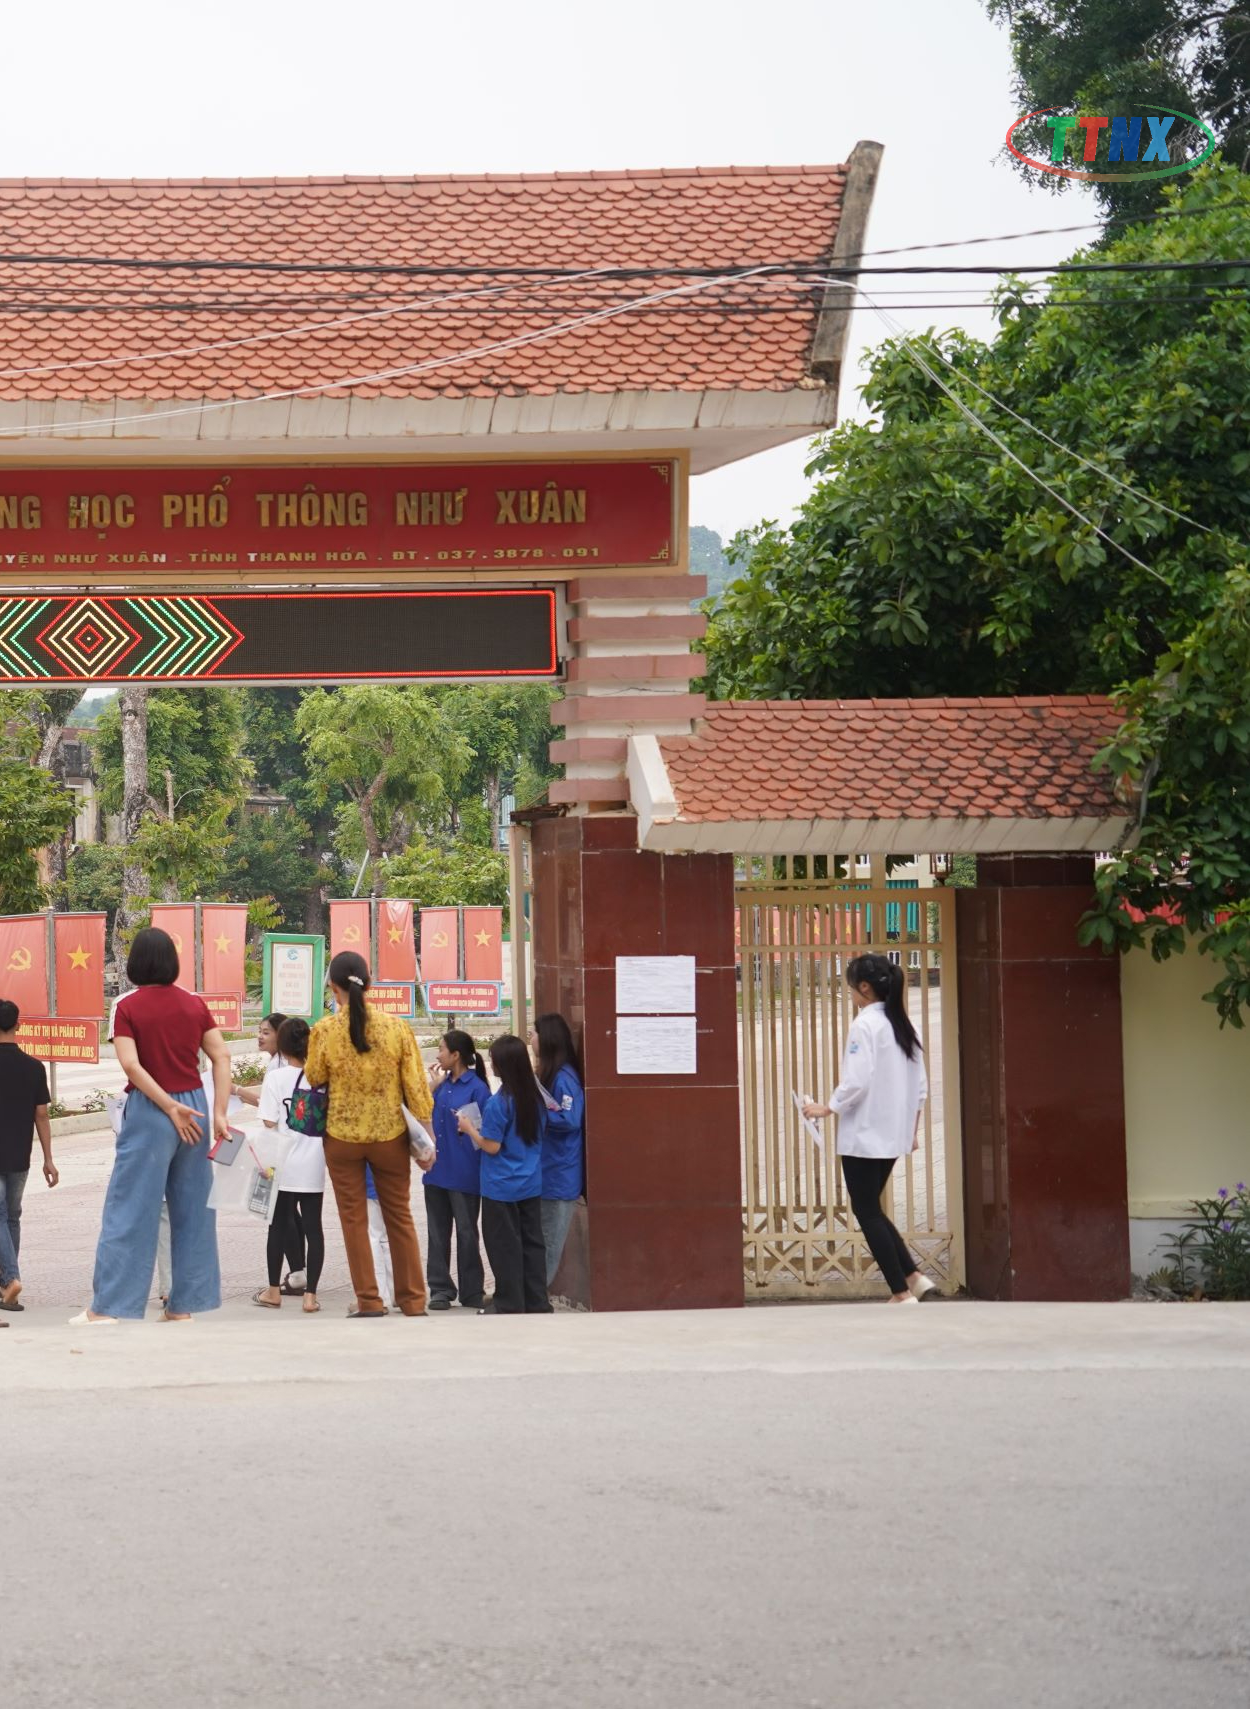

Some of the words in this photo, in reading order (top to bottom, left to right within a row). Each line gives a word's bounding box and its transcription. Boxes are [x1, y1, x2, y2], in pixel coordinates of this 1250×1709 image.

[68, 494, 135, 540] HỌC
[162, 476, 232, 528] PHỔ
[256, 484, 368, 528] THÔNG
[396, 487, 468, 526] NHƯ
[495, 482, 587, 525] XUÂN
[54, 554, 98, 564] NHƯ
[108, 551, 166, 564] XUÂN
[248, 552, 316, 562] THANH
